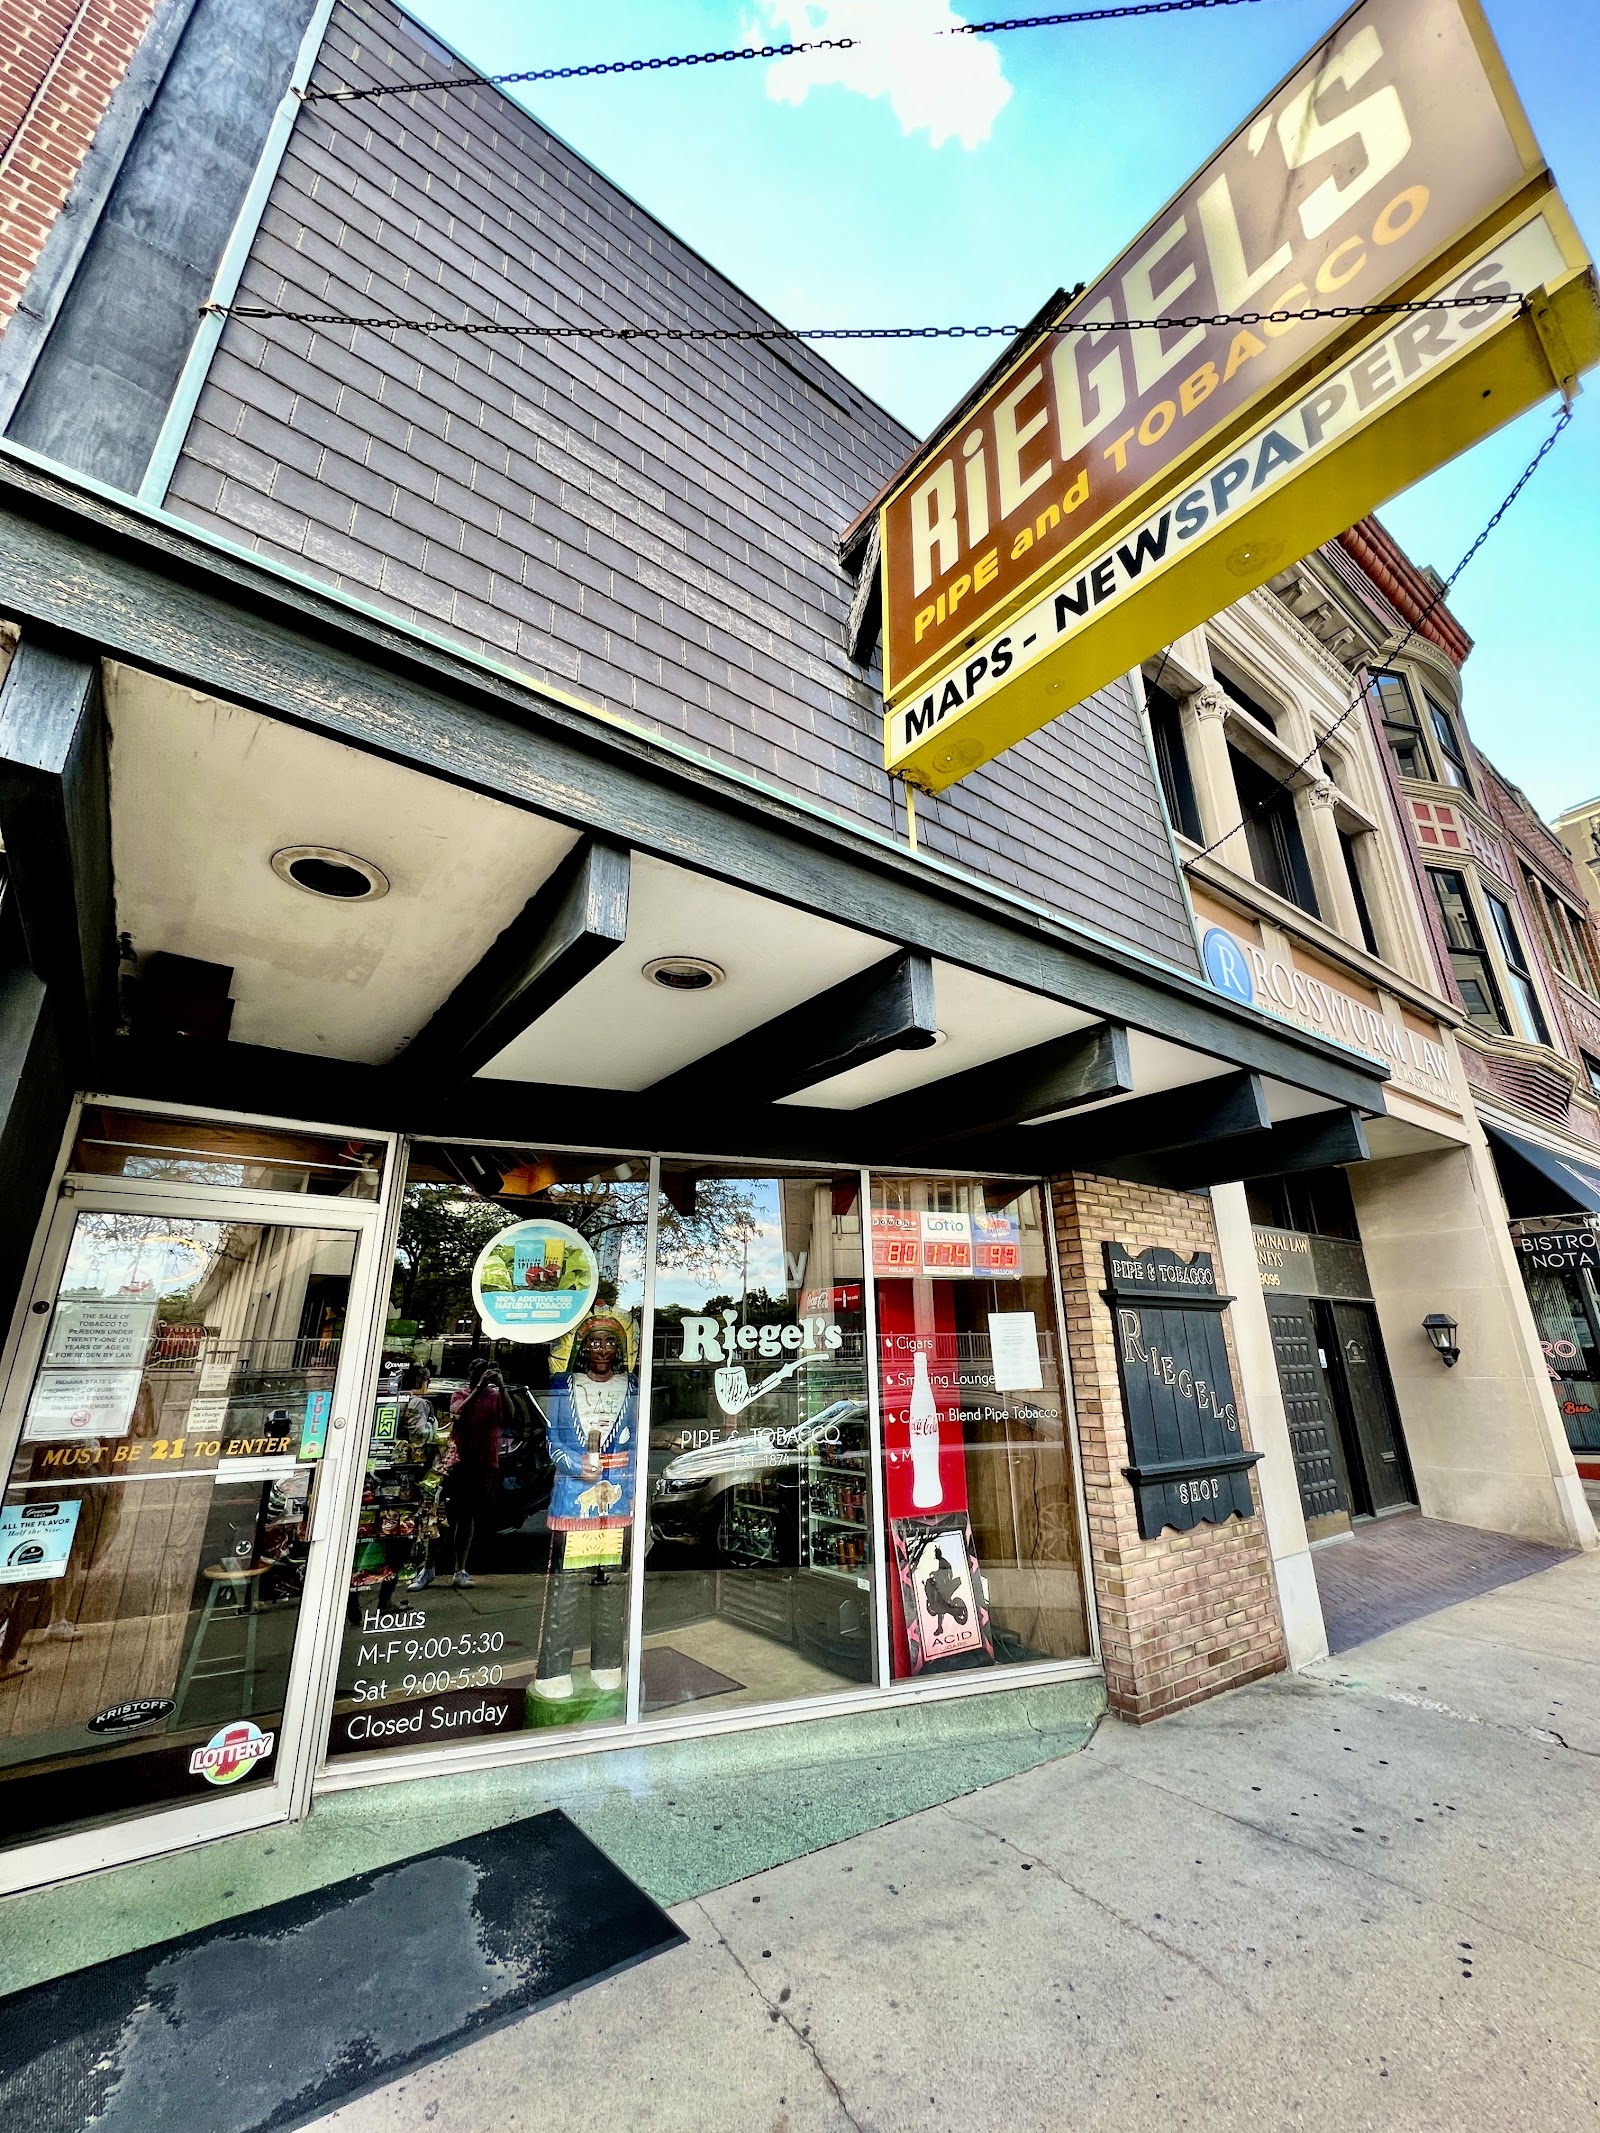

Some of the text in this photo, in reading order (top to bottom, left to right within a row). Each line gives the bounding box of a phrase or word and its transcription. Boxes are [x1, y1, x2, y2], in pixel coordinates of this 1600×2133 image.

[914, 185, 1430, 644] PIPE and TOBACCO
[1055, 263, 1512, 632] NEWSPAPERS
[1216, 943, 1247, 996] R
[1247, 948, 1452, 1084] ROSSWURM LAW
[888, 1242, 917, 1264] 80
[1252, 1232, 1308, 1253] IMINAL LAW
[1521, 1234, 1596, 1252] BISTRO
[929, 1244, 968, 1265] 17.4
[990, 1246, 1016, 1267] 99
[1532, 1252, 1594, 1268] NOTA
[1112, 1260, 1214, 1285] PIPE & TOBACCO
[679, 1309, 842, 1362] Riegel's
[896, 1336, 933, 1350] Cigars
[898, 1372, 996, 1388] Sming Lounge
[1118, 1309, 1237, 1432] RIEGELS
[311, 1395, 325, 1434] PULL
[949, 1408, 981, 1422] Blend
[985, 1407, 1009, 1423] Pipe
[1012, 1406, 1057, 1419] Tobacco
[750, 1424, 840, 1445] TOBACCO
[41, 1446, 109, 1467] MUST
[112, 1445, 142, 1463] BE
[150, 1438, 186, 1460] 21
[193, 1441, 221, 1458] TO
[225, 1436, 292, 1455] ENTER
[734, 1453, 790, 1468] EST. 1874
[1179, 1478, 1220, 1504] SHOP
[8, 1529, 27, 1537] Half
[38, 1518, 70, 1527] FLAVOR
[363, 1609, 426, 1631] Hours
[357, 1632, 504, 1666] M-F 9:00-5:30
[932, 1631, 972, 1647] ACID
[352, 1665, 503, 1703] Sat 9:00-5:30
[96, 1701, 168, 1724] KRISTOFF
[347, 1701, 509, 1740] Closed Sunday
[193, 1735, 272, 1770] LOTTERY
